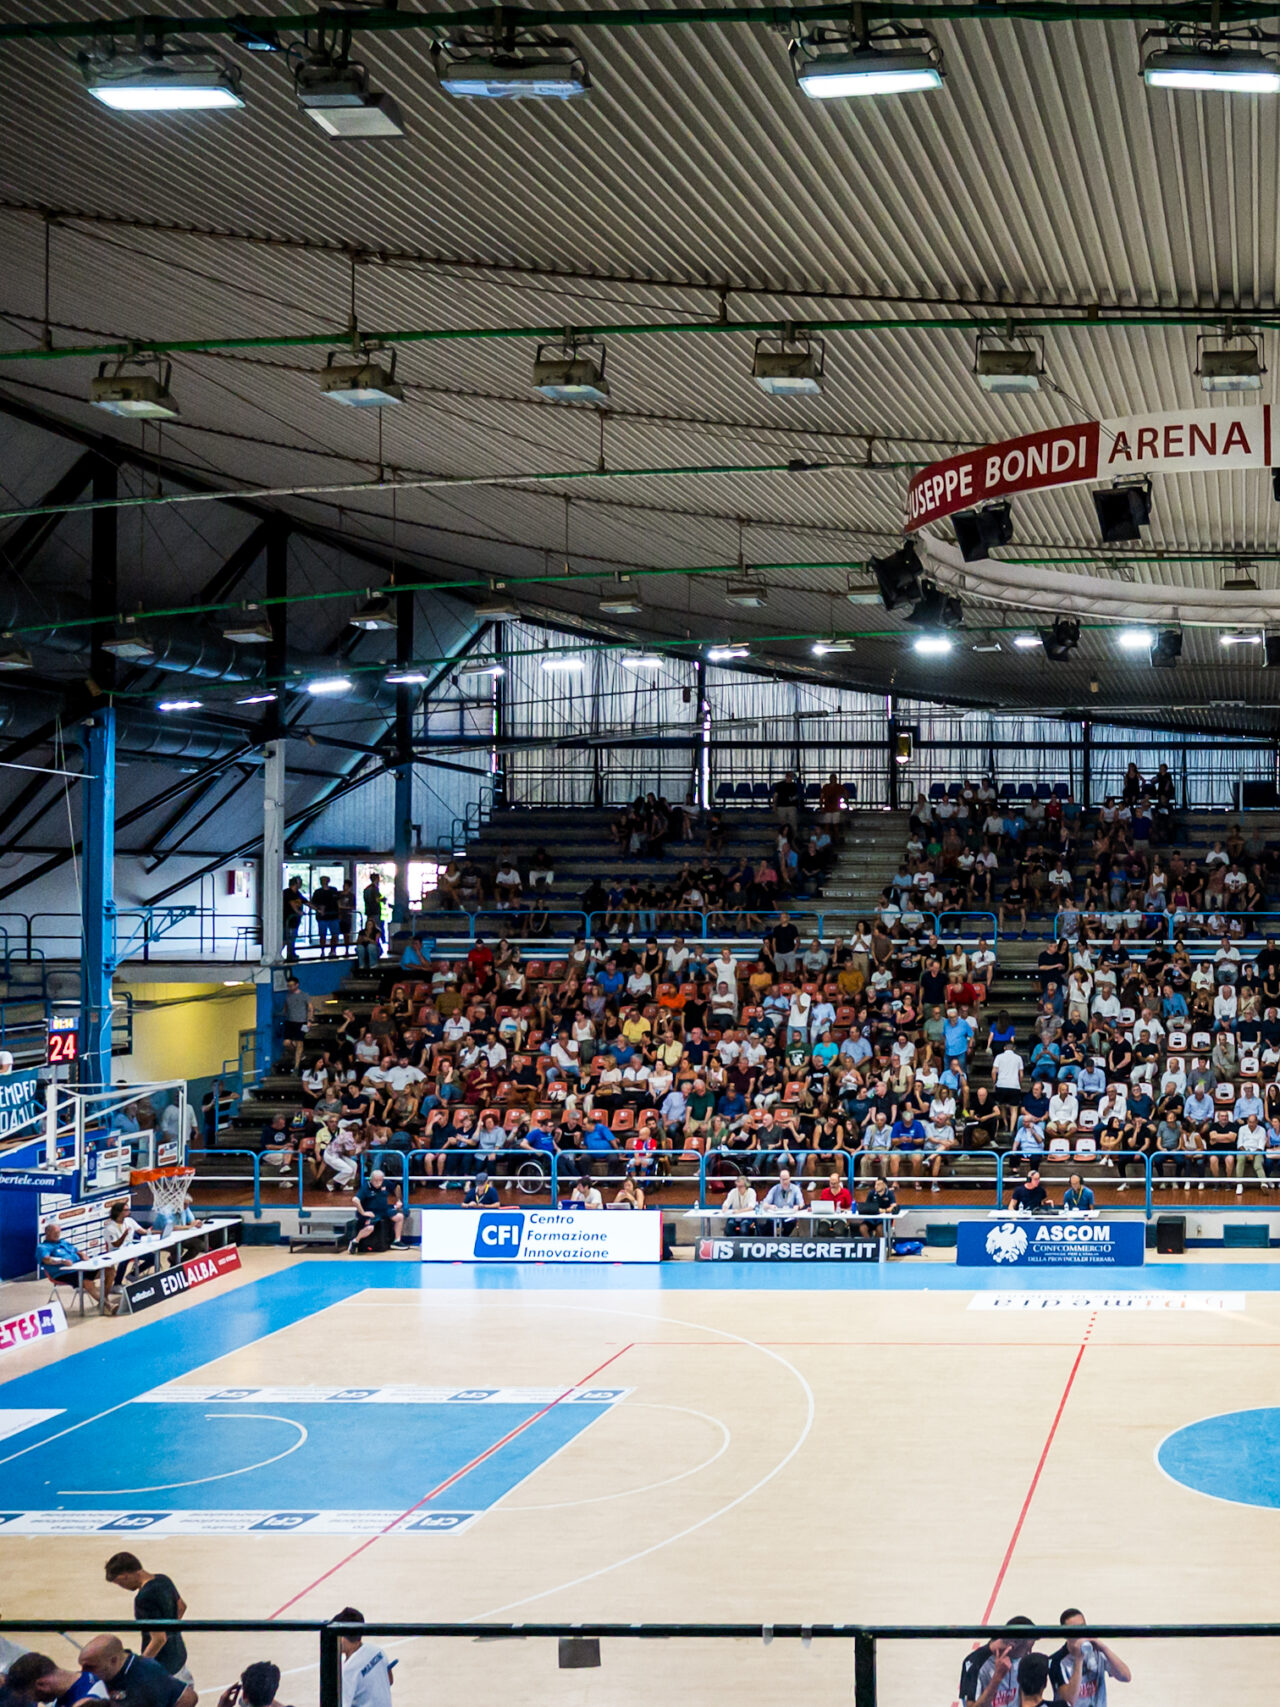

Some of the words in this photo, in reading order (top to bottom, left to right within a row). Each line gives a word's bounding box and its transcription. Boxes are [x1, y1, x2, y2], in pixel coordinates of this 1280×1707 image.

[1107, 420, 1252, 464] ARENA
[985, 436, 1087, 488] BONDI
[49, 1033, 76, 1062] 24
[530, 1213, 575, 1224] Centro
[481, 1225, 519, 1246] CFI
[527, 1230, 608, 1241] Formazione
[1035, 1225, 1111, 1241] ASCOM
[523, 1247, 609, 1258] Innovazione
[739, 1242, 877, 1259] TOPSECRET.IT
[160, 1258, 219, 1296] EDILALBA
